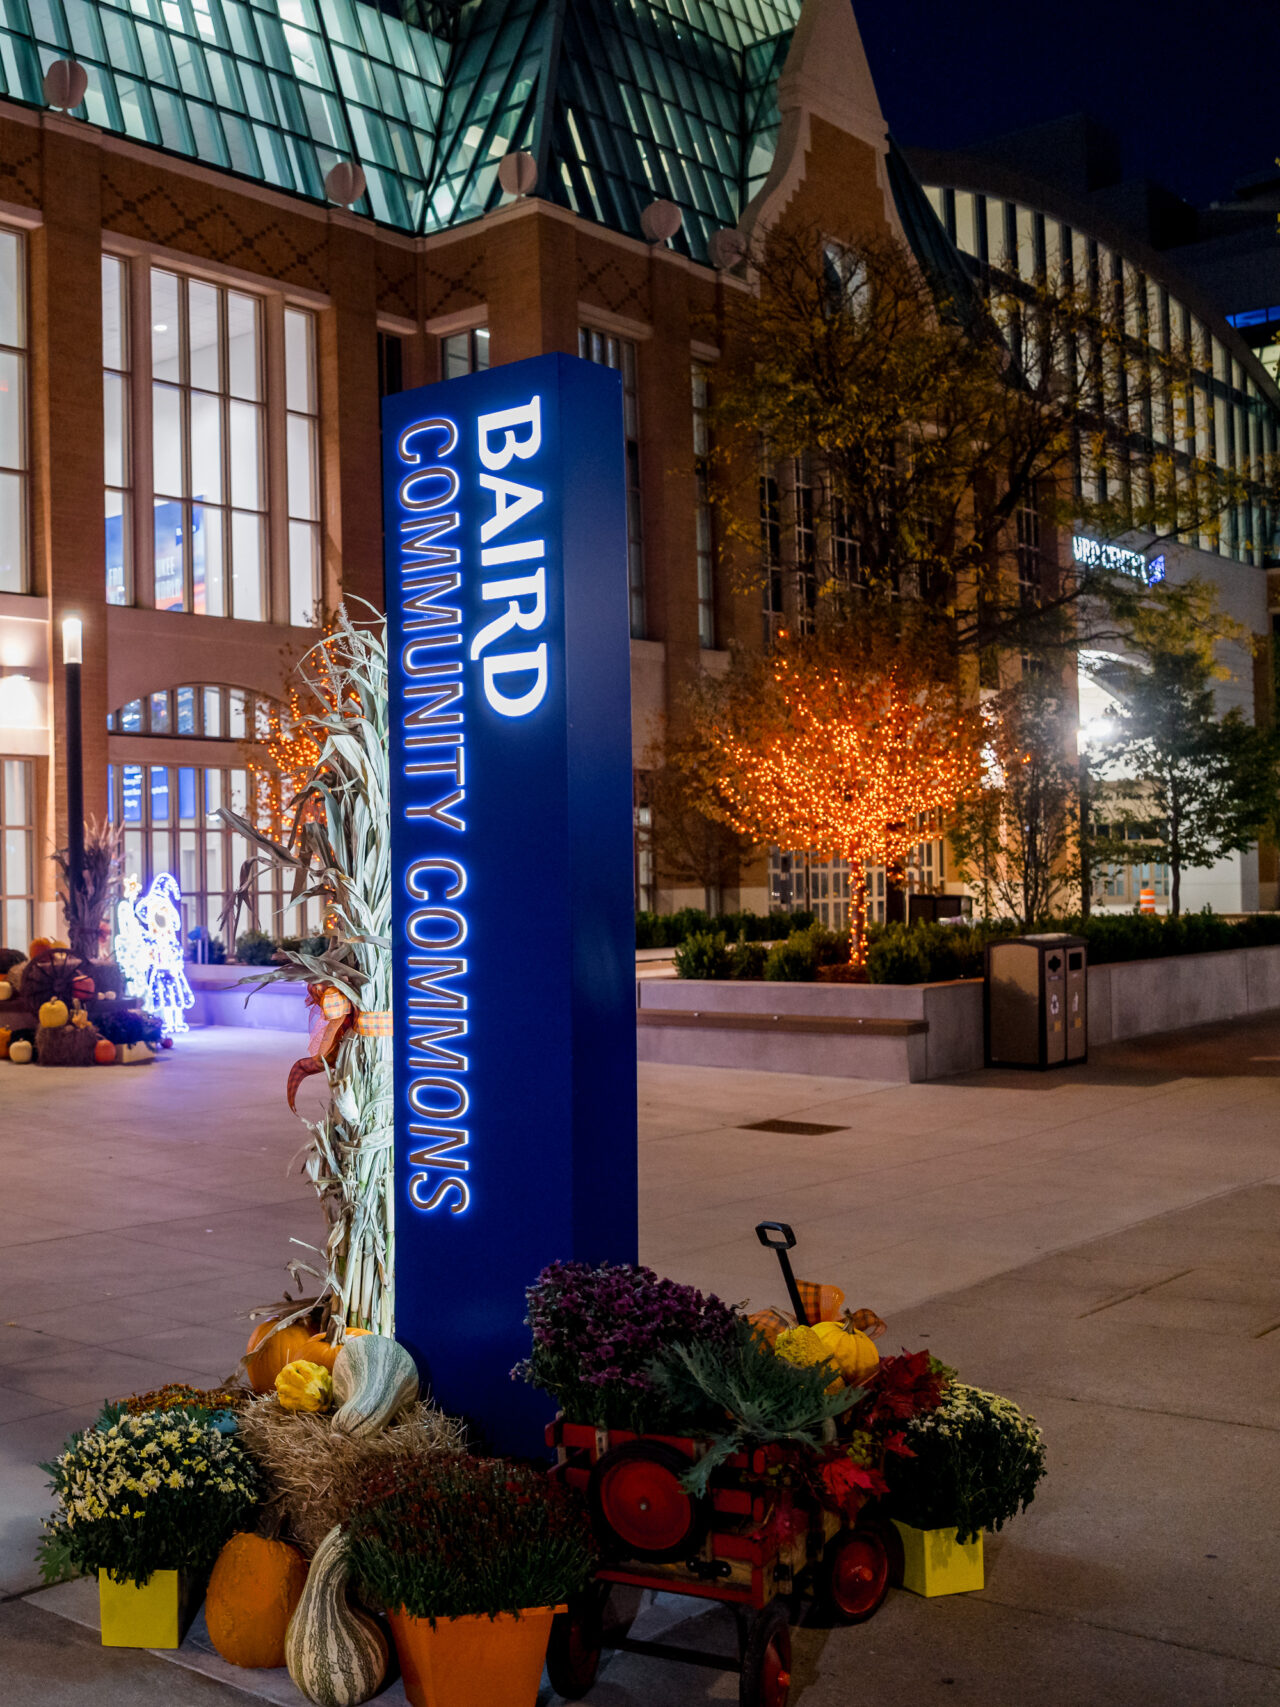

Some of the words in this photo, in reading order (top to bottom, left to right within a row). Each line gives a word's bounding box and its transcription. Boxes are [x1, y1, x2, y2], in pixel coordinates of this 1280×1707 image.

[398, 417, 466, 832] COMMUNITY
[470, 395, 548, 717] BAIRD
[405, 858, 470, 1214] COMMONS
